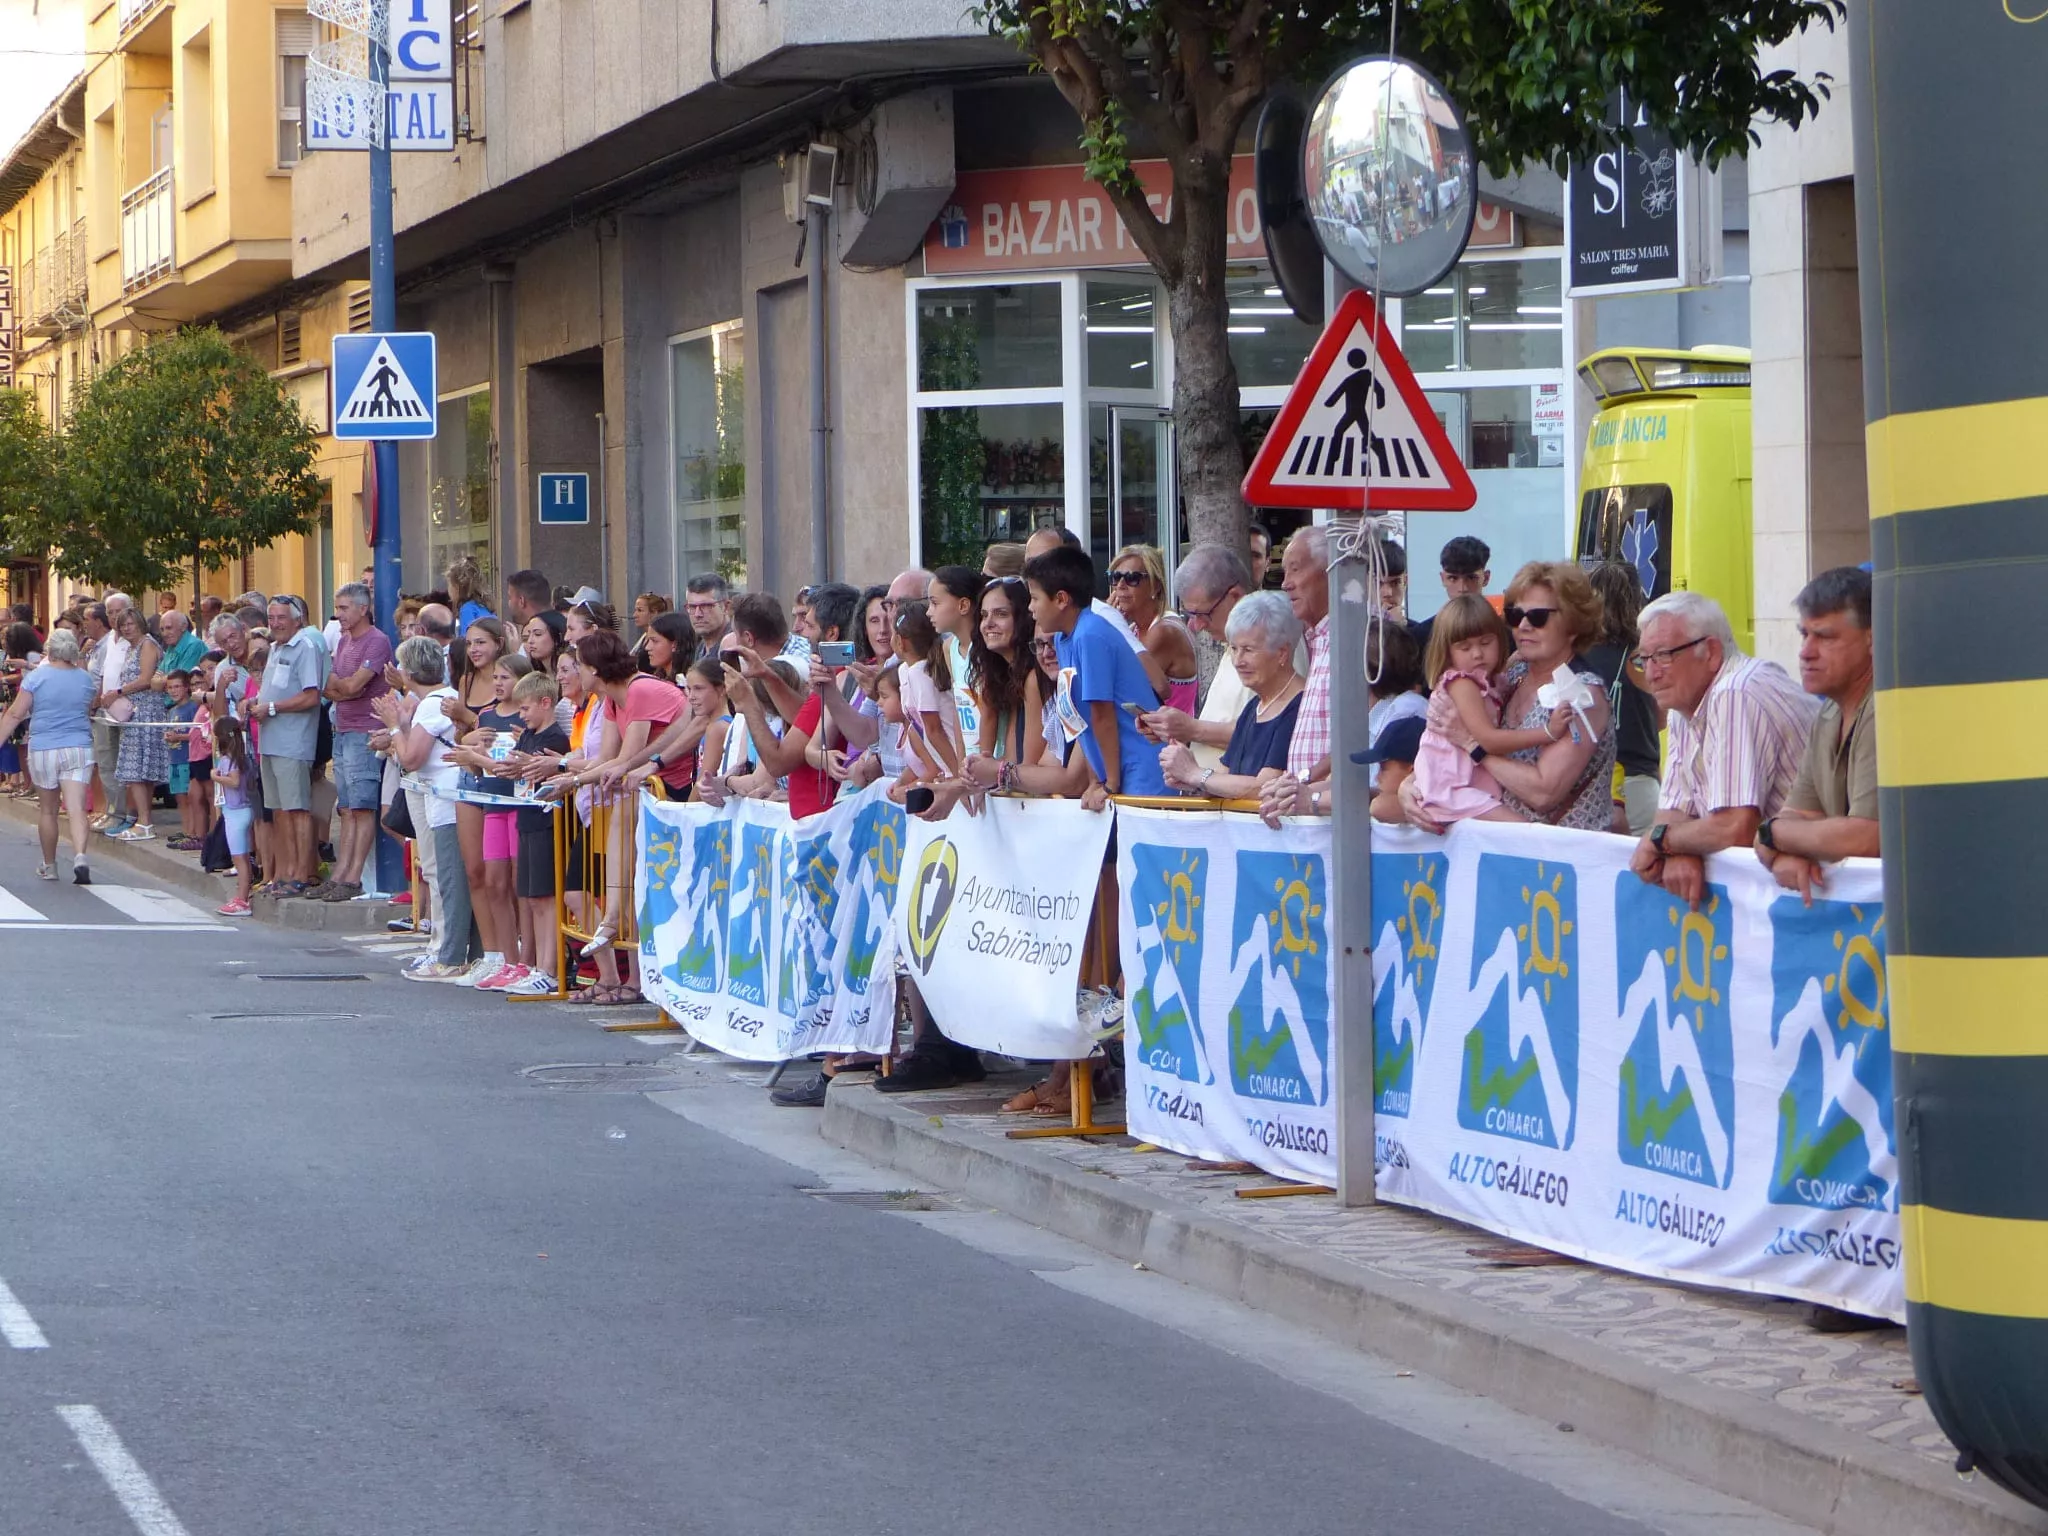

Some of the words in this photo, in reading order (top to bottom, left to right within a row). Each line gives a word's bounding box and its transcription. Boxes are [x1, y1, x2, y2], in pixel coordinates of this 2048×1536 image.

[1593, 152, 1620, 214] S
[983, 197, 1104, 256] BAZAR
[1580, 250, 1611, 265] SALON
[1612, 247, 1637, 261] TRES
[1638, 245, 1668, 259] MARIA
[1611, 263, 1638, 275] coiffeur
[958, 875, 1080, 921] Ayuntamiento
[1249, 1074, 1301, 1099] COMARCA
[1485, 1106, 1544, 1141] COMARCA
[1448, 1151, 1569, 1207] ALTOGÁLLEGO
[1644, 1141, 1703, 1178] COMARCA
[1615, 1189, 1725, 1248] ALTOGÁLLEGO
